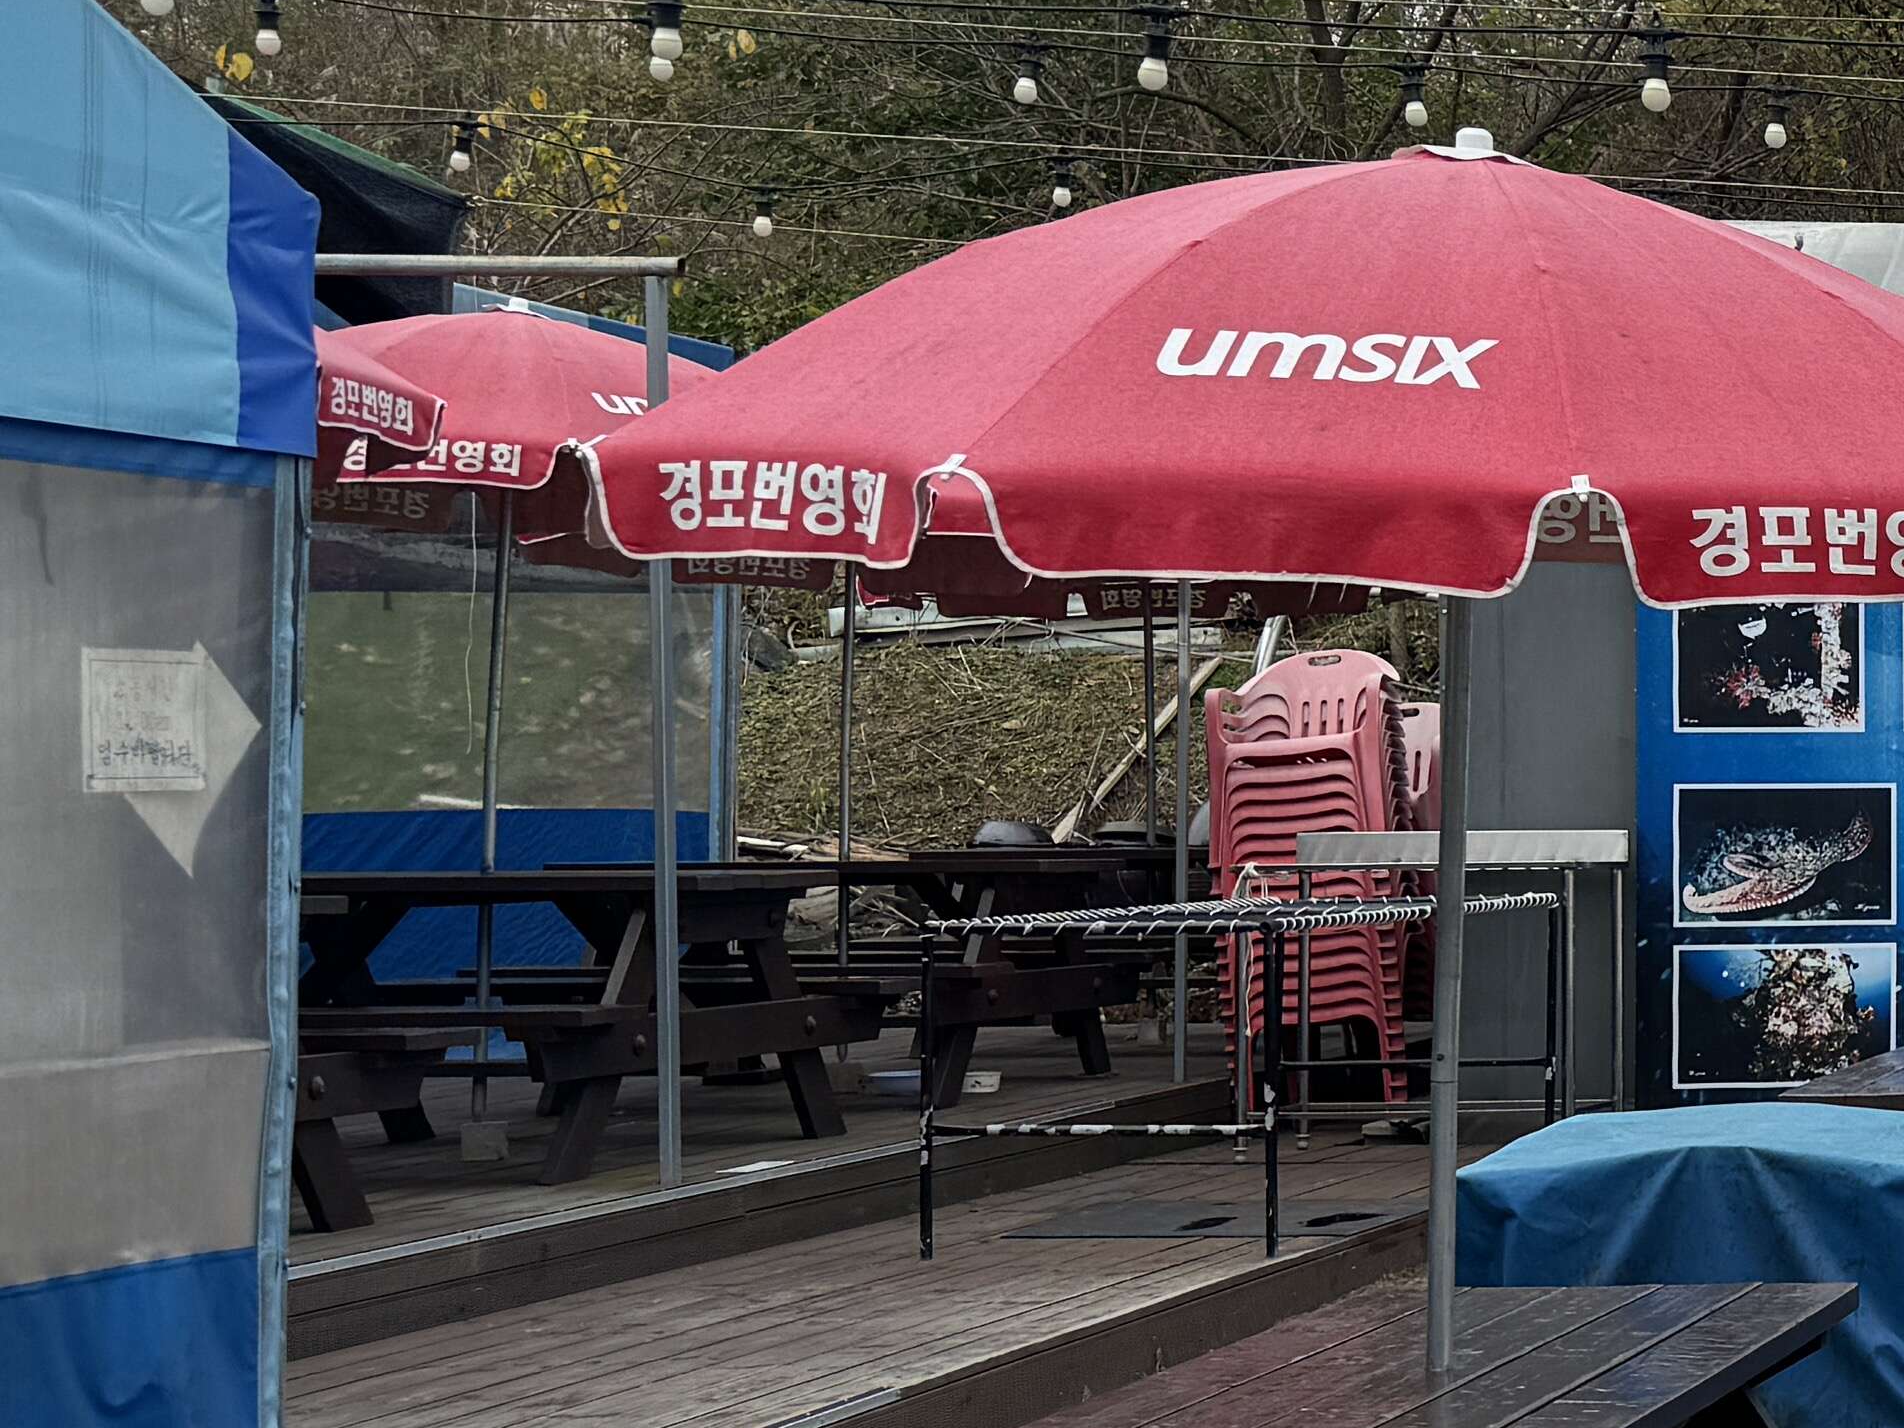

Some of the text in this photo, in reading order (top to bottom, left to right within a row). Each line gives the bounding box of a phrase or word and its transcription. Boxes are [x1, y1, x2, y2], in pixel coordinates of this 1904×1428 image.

[1156, 327, 1499, 390] umsix
[331, 376, 414, 435] 경포번영회
[659, 459, 888, 545] 경포번영회
